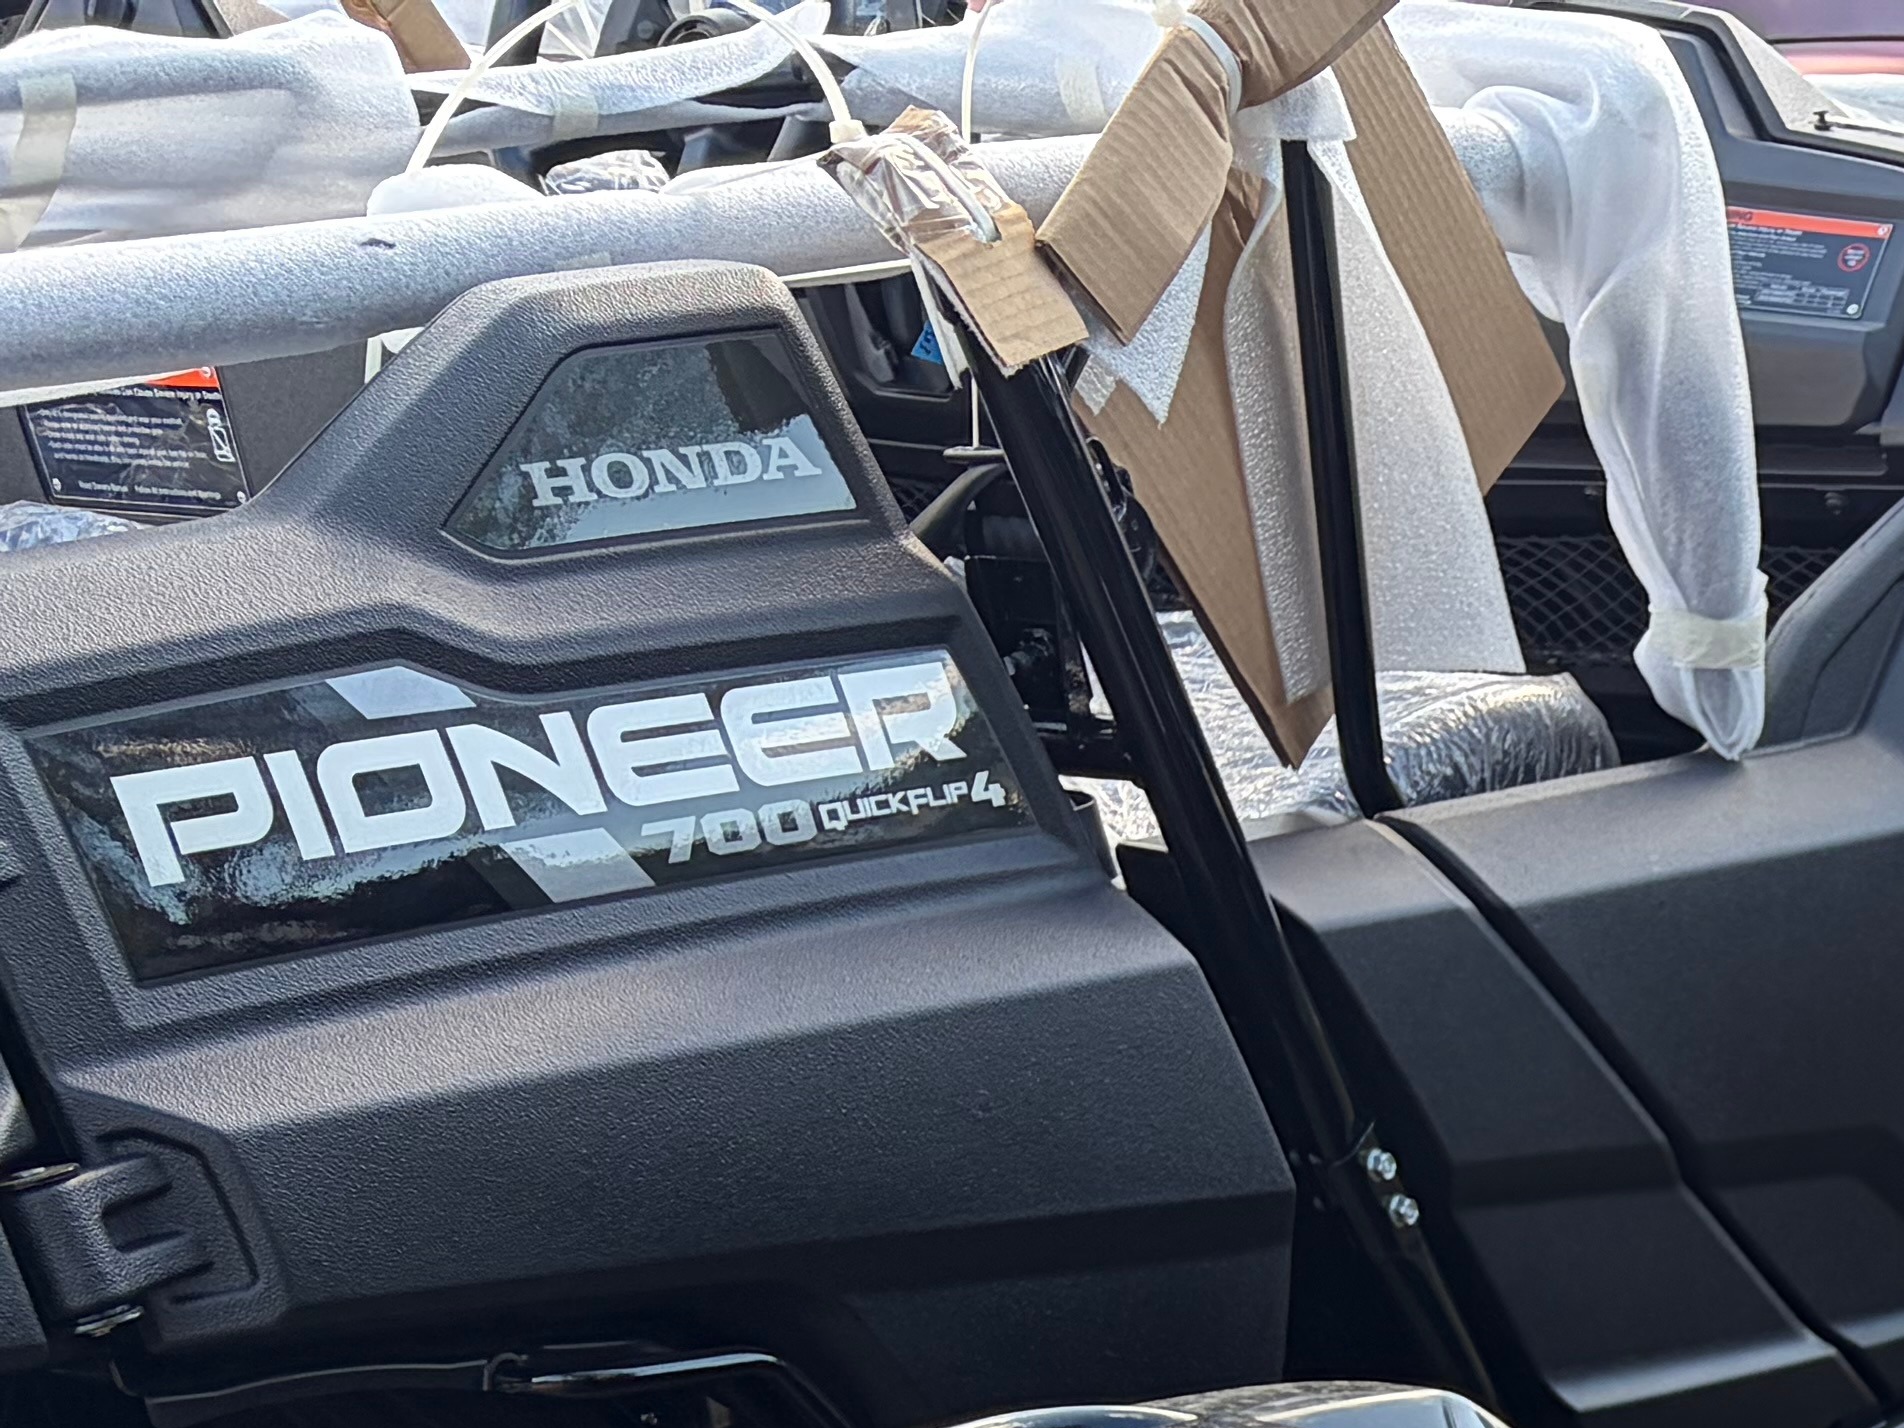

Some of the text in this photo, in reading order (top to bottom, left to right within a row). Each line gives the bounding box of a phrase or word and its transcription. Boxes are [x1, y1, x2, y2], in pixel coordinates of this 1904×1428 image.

[519, 436, 822, 507] HONDA
[111, 662, 968, 886] PIONEER
[640, 798, 818, 865] 700
